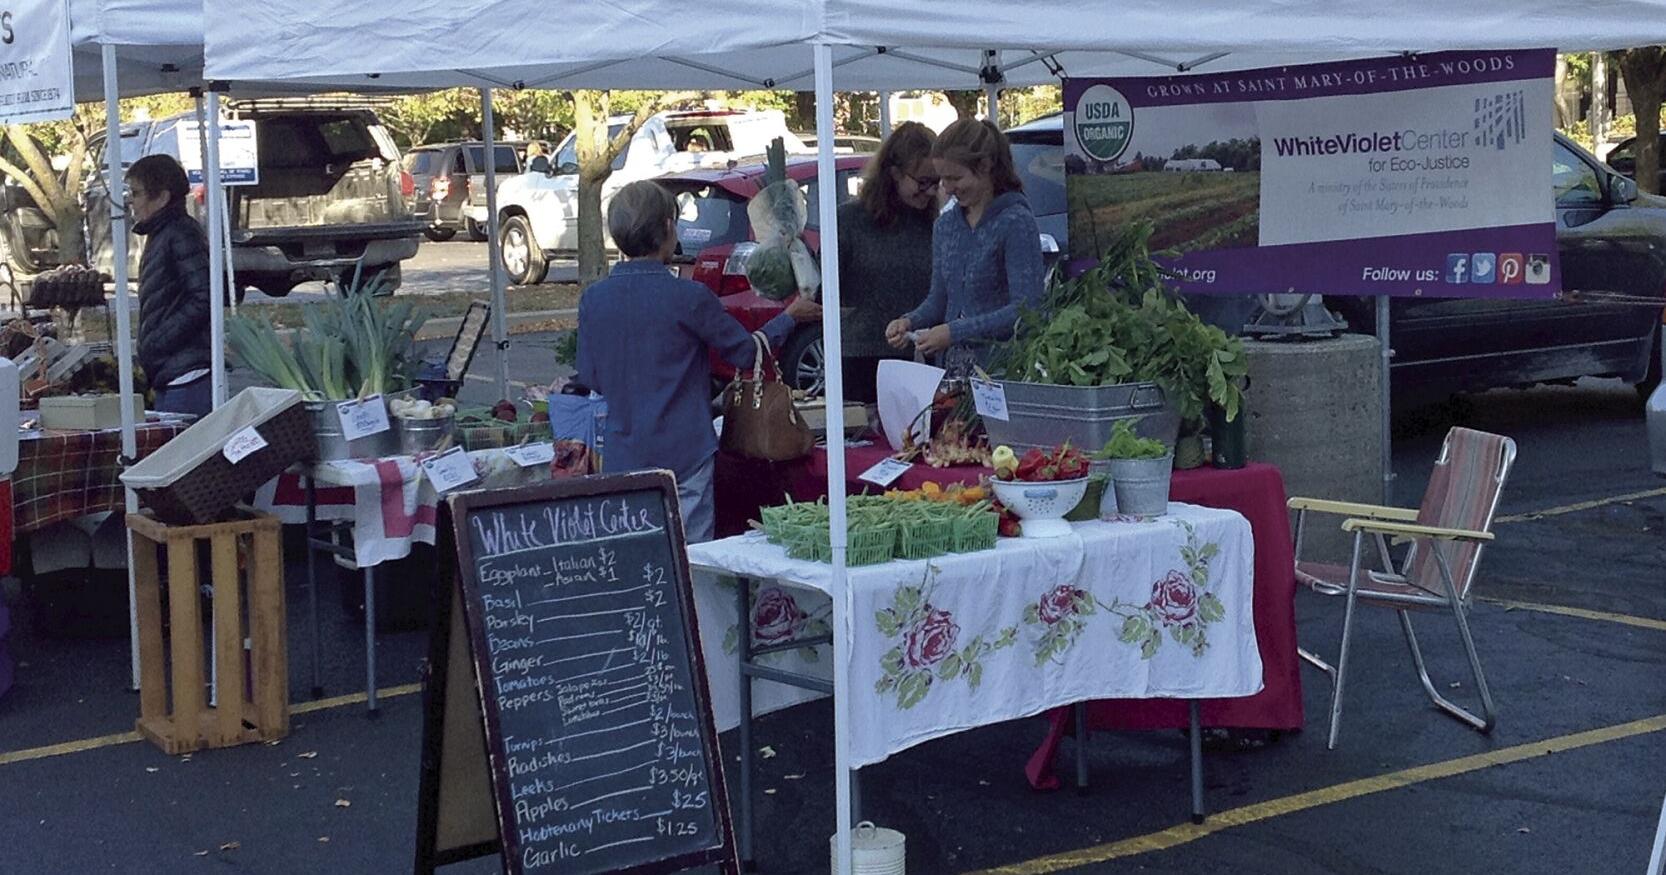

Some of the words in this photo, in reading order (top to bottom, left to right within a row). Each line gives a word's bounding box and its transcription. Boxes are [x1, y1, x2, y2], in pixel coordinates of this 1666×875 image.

[1147, 83, 1205, 98] GROWN
[1213, 80, 1230, 94] AT
[1239, 76, 1287, 93] SAINT
[1295, 55, 1515, 90] MARY-OF-THE-WOODS
[1085, 102, 1120, 119] USDA
[1083, 125, 1125, 141] ORGANIC
[1368, 159, 1387, 173] for
[1390, 156, 1470, 172] Eco-Justice
[1309, 182, 1315, 193] A
[1364, 179, 1377, 191] the
[1362, 267, 1410, 281] Follow
[1415, 267, 1439, 281] us:
[472, 512, 546, 556] White
[543, 503, 597, 545] Violet
[601, 499, 657, 534] Center
[479, 562, 542, 587] Eggplant
[599, 546, 616, 566] $2
[599, 567, 619, 581] $1
[482, 589, 522, 612] Basil
[643, 562, 667, 585] $2
[486, 609, 534, 633] Parsley
[644, 589, 667, 608] $2
[492, 655, 544, 675] Ginger
[494, 675, 555, 695] Tomatoes
[504, 735, 542, 754] Turnips
[508, 752, 571, 778] Radishes
[510, 778, 554, 800] Leeks
[671, 788, 707, 809] $25
[515, 797, 569, 825] Apples
[523, 841, 580, 869] Garlic
